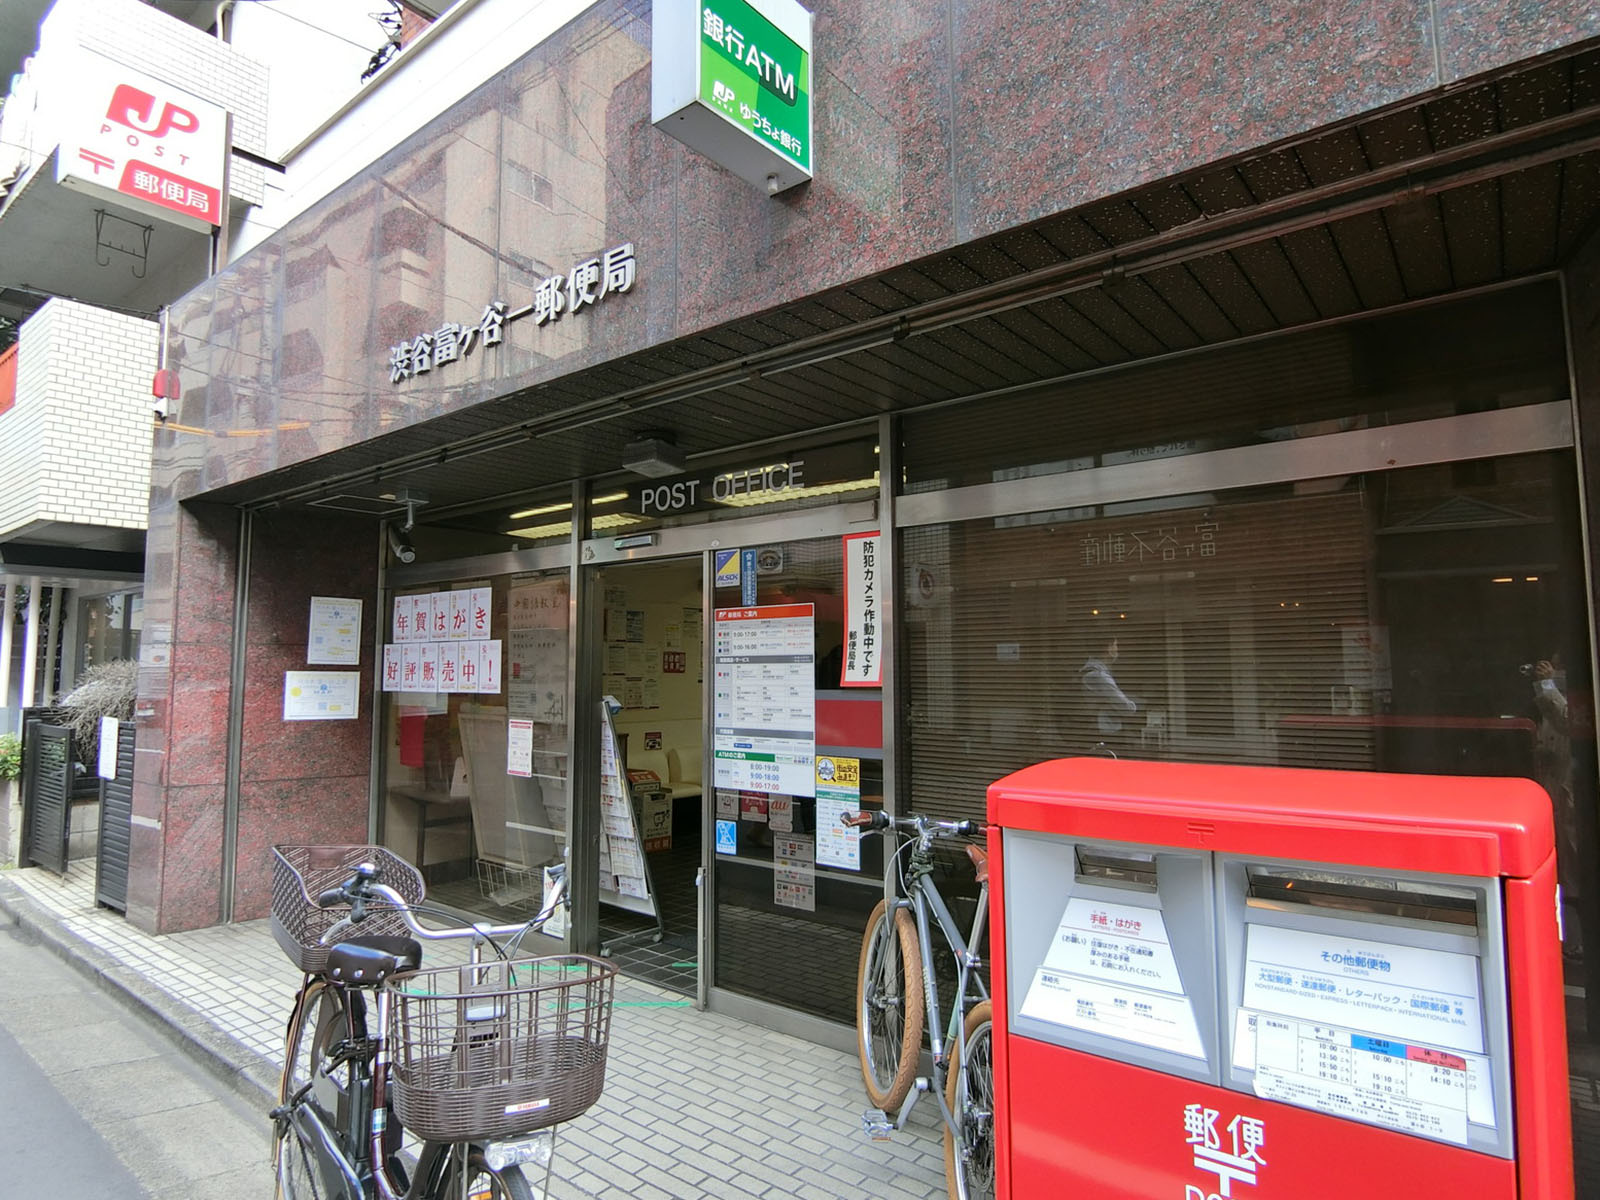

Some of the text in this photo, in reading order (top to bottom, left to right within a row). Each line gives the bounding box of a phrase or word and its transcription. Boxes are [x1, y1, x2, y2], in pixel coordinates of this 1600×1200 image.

[703, 7, 795, 101] 銀行ATM
[100, 123, 190, 166] POST
[739, 101, 802, 157] ゆうちょ銀行
[133, 169, 209, 214] 郵便局
[641, 460, 806, 514] POST OFFICE
[717, 573, 739, 582] ALSOK
[397, 605, 487, 634] 年賀はがき
[862, 540, 876, 678] 防犯カメラ作動中です
[847, 630, 858, 671] 郵便局長
[771, 800, 790, 811] au
[1090, 913, 1143, 931] 手紙・はがき
[1320, 950, 1391, 973] その他郵便物
[1343, 966, 1370, 976] OTHERS
[1183, 1104, 1268, 1166] 郵便
